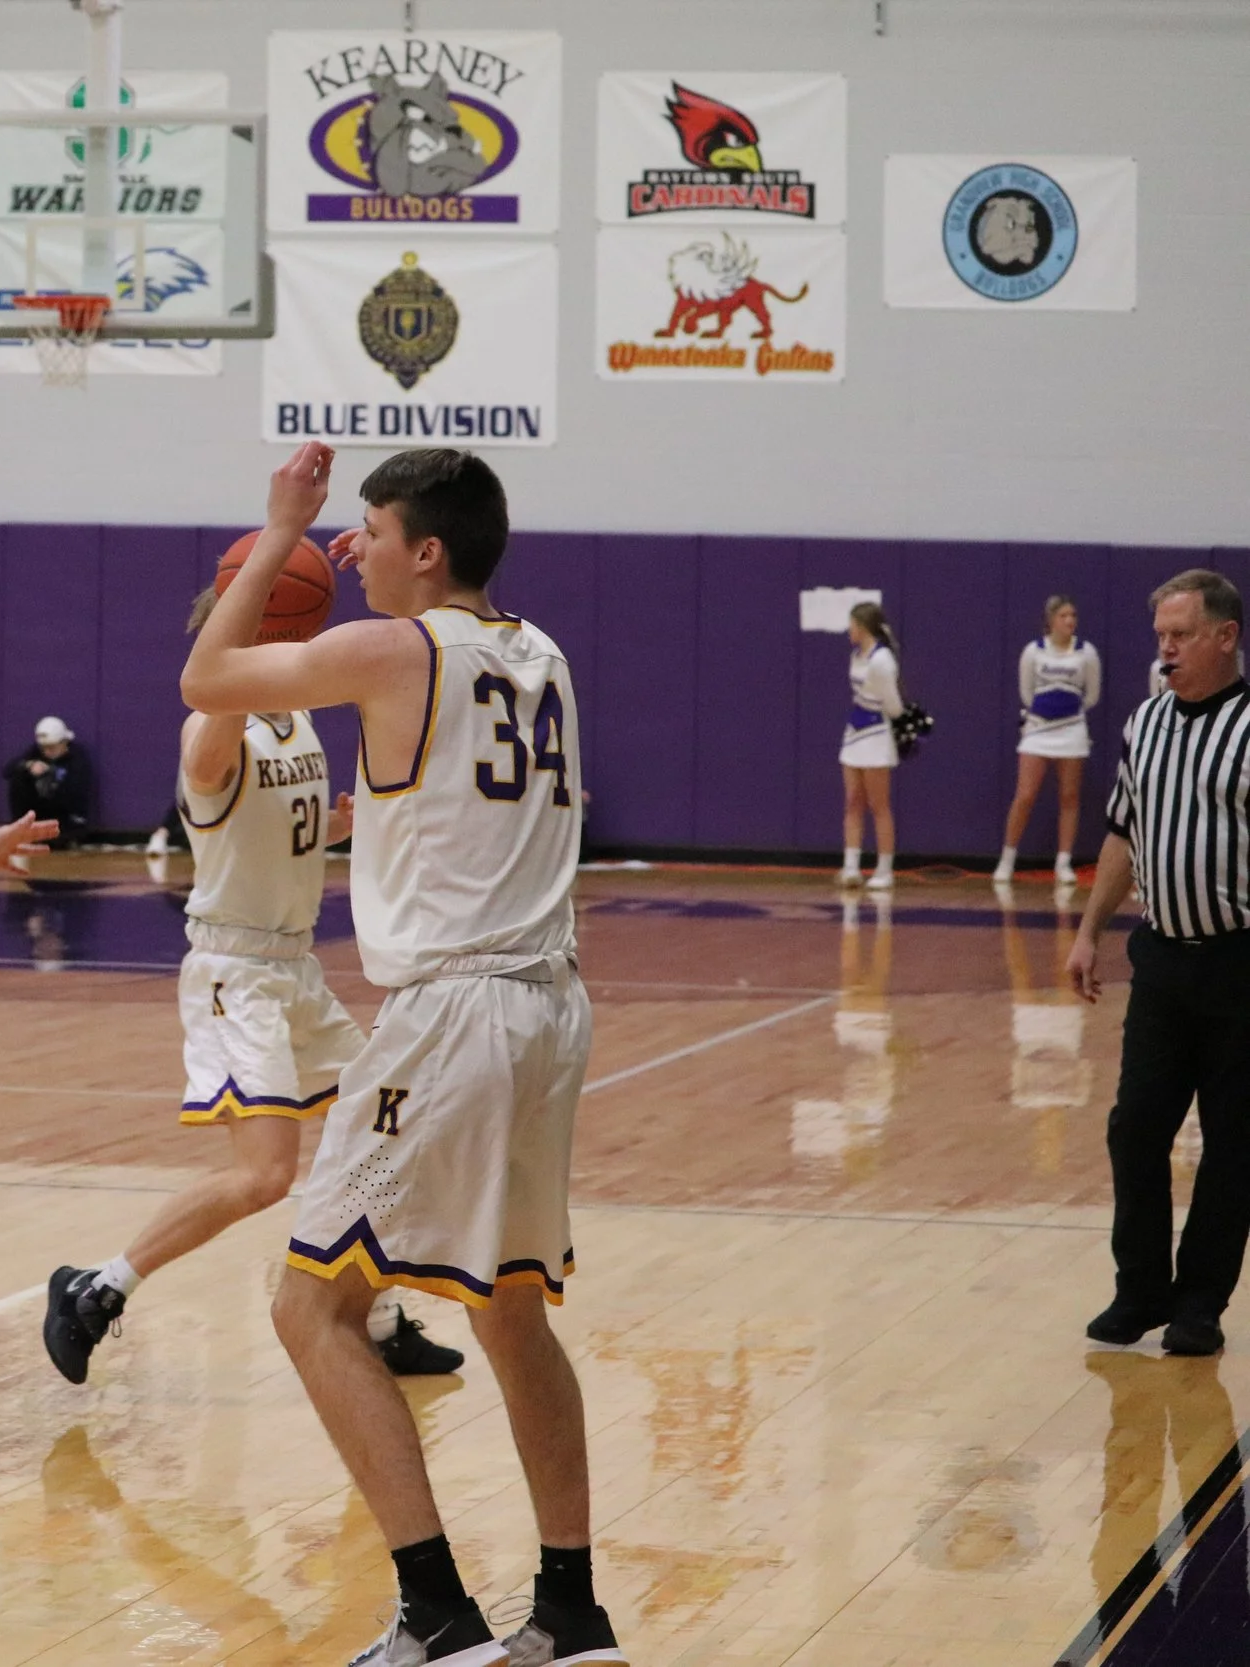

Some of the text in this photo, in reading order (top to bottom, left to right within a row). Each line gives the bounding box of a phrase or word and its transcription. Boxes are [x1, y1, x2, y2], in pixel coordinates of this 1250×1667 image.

[303, 38, 526, 99] KEARNEY
[9, 184, 203, 214] WARIORS
[350, 198, 475, 221] BULLDOGS
[630, 183, 810, 215] CARDINALS
[278, 403, 540, 439] BLUE DIVISION
[472, 670, 571, 808] 34
[211, 981, 226, 1017] K
[372, 1086, 410, 1137] K
